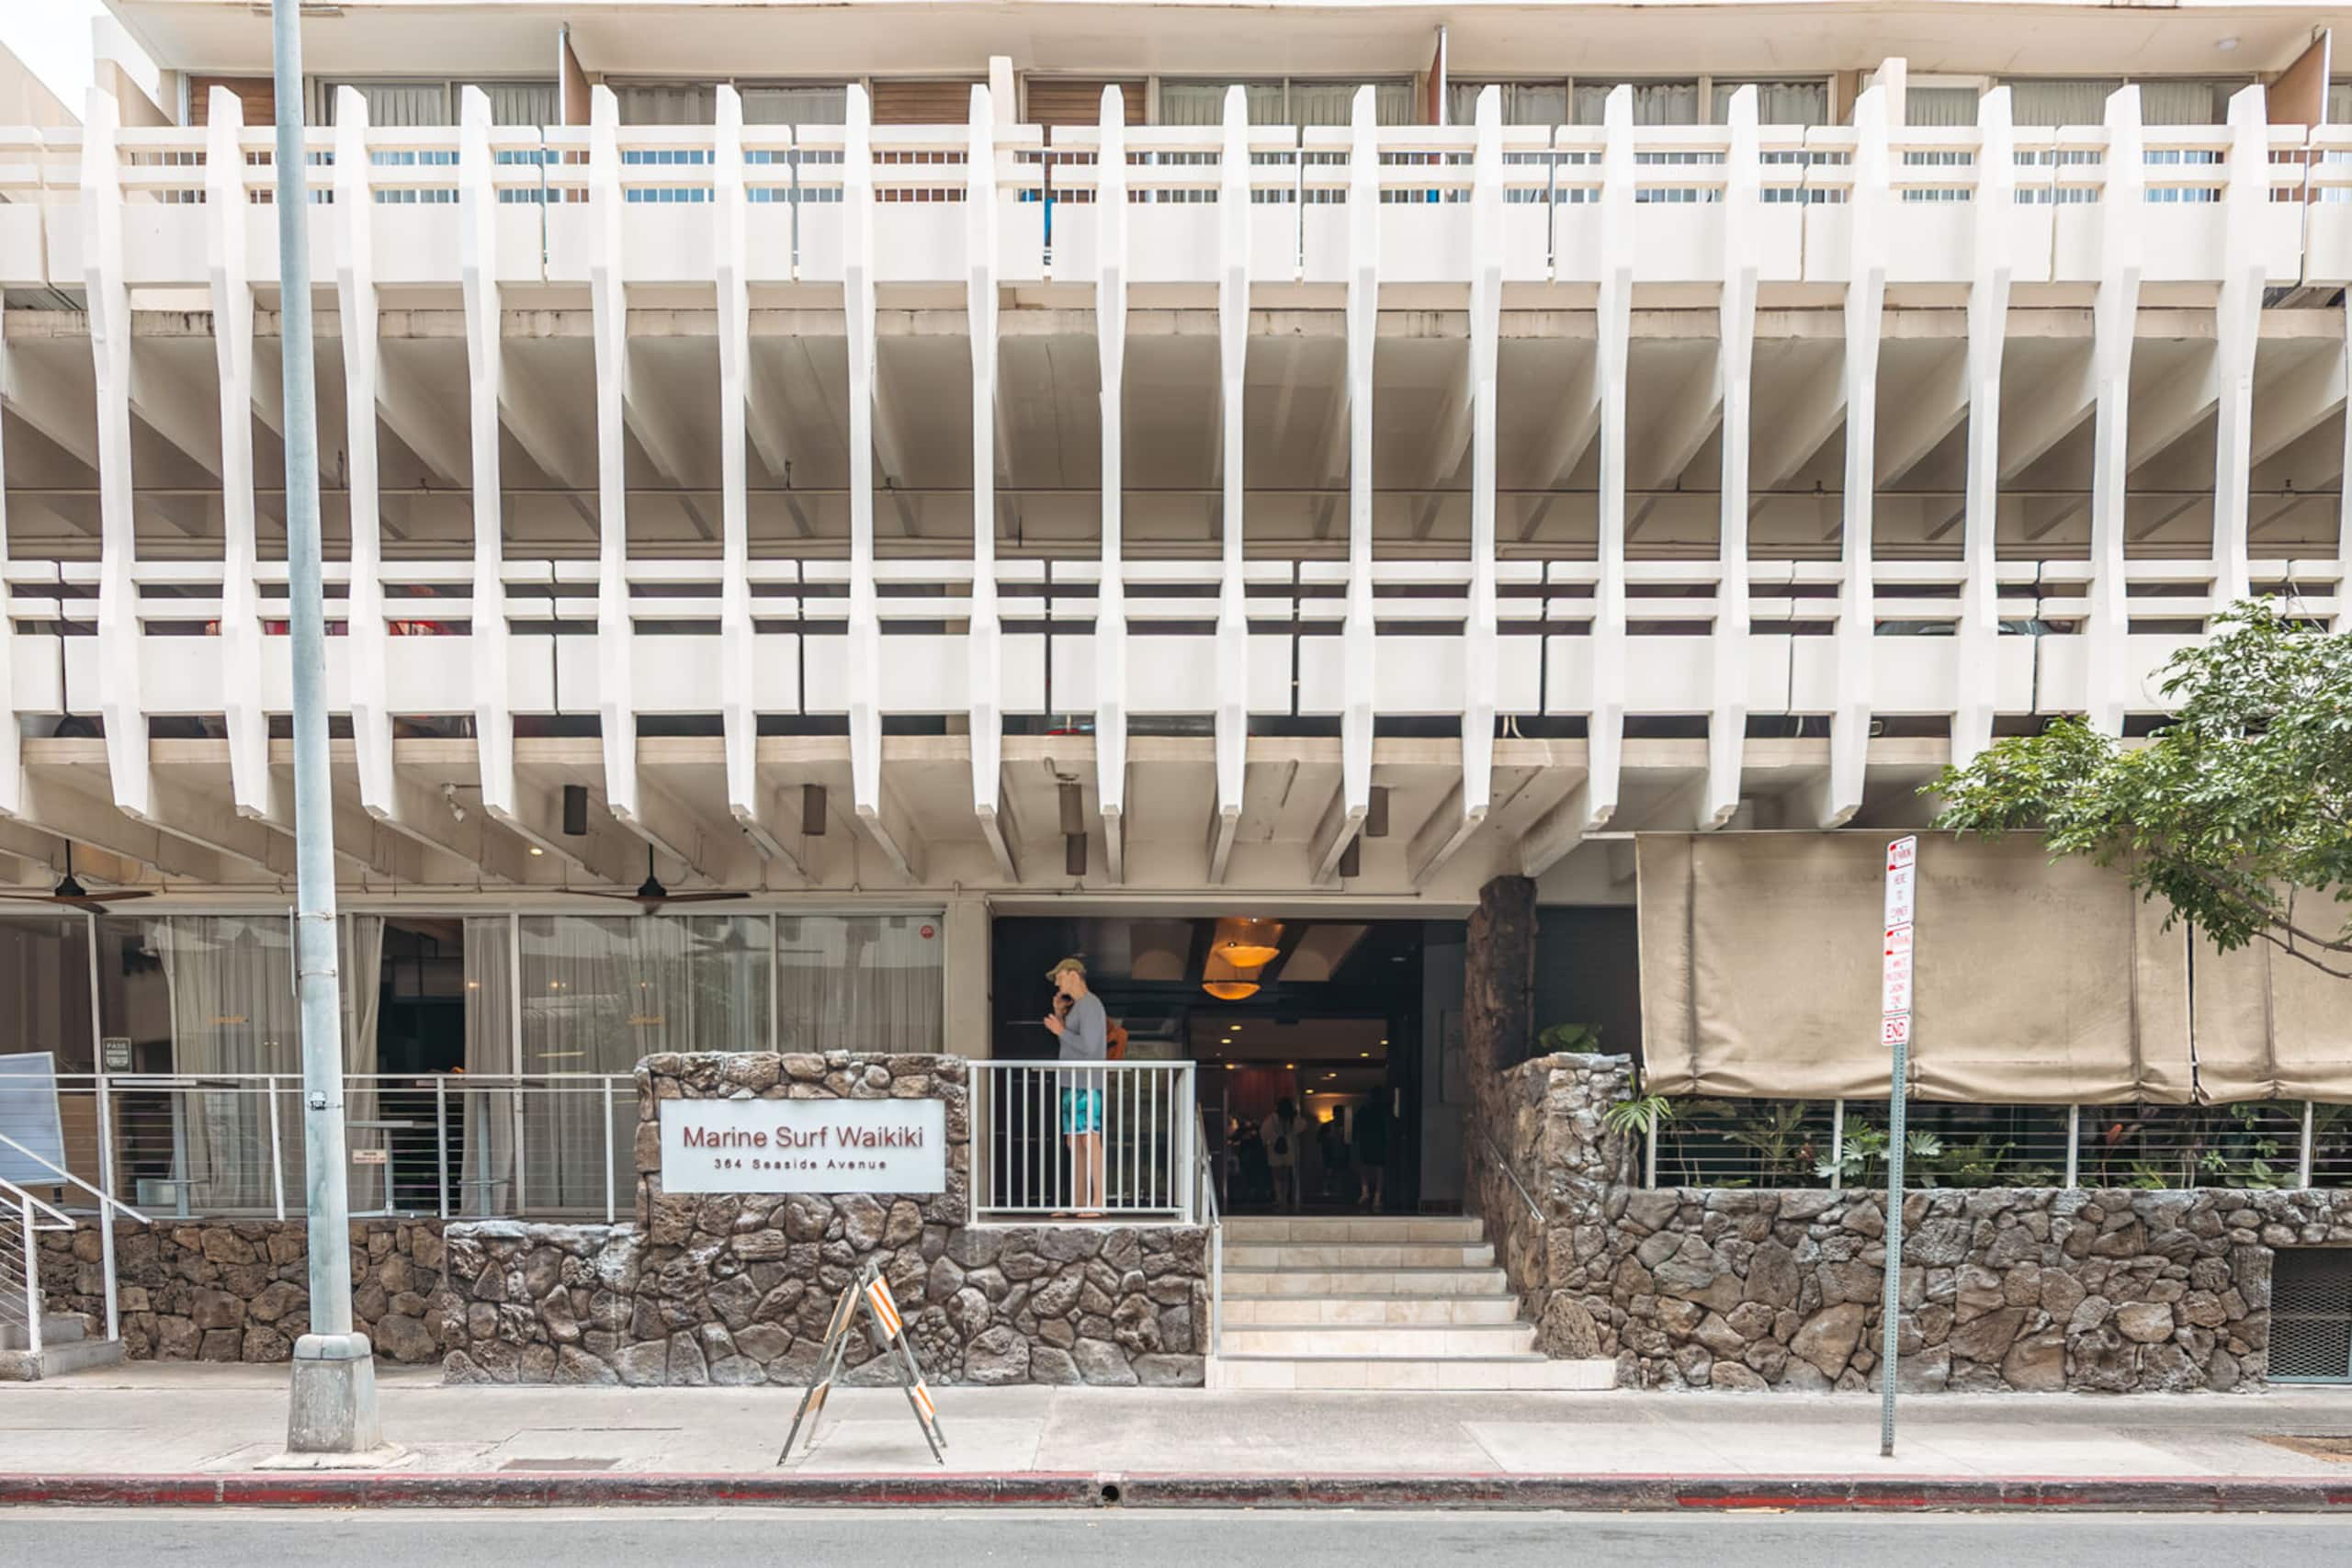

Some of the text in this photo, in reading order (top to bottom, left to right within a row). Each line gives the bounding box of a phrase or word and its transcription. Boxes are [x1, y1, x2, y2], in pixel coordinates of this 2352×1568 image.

[684, 1126, 923, 1147] Marine Surf Waikiki
[715, 1158, 887, 1169] 364 Seaside Avenue
